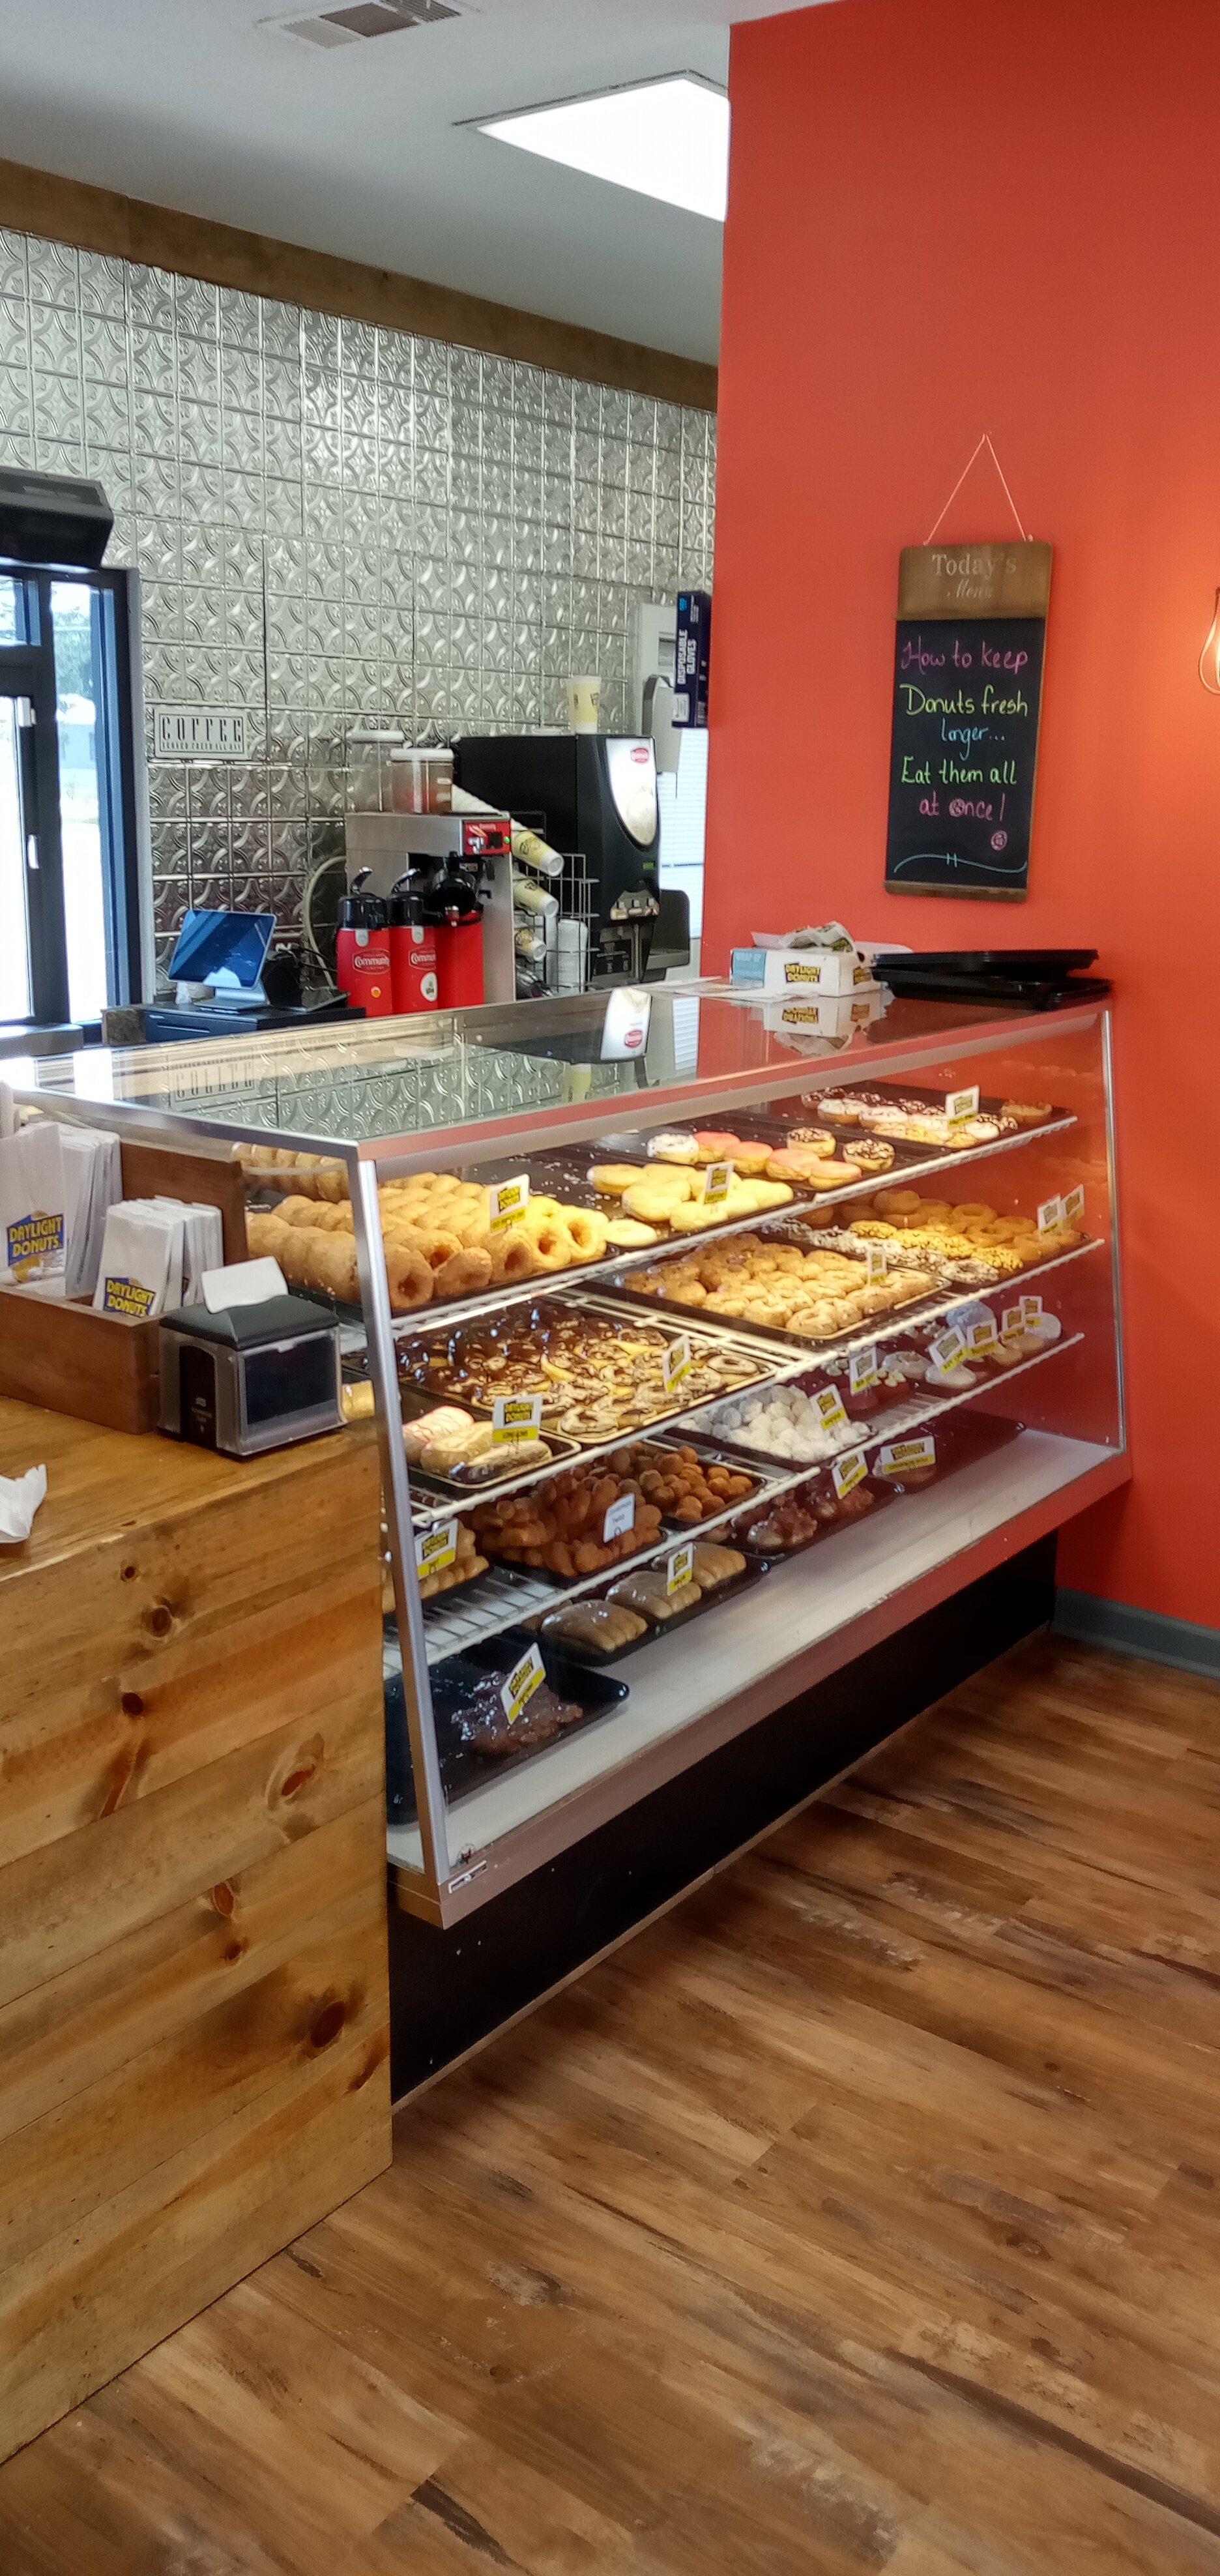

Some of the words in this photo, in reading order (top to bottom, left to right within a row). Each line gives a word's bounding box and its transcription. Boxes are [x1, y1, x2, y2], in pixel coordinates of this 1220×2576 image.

[931, 552, 1017, 579] Today's
[677, 629, 688, 684] DISPOSABLE
[686, 639, 697, 675] GLOVES
[901, 636, 945, 675] How
[952, 639, 972, 668] to
[981, 640, 1028, 674] keep
[899, 683, 976, 716] Donuts
[981, 684, 1028, 717] fresh
[162, 716, 241, 742] COFFEE
[901, 755, 931, 784] Eat
[938, 758, 983, 784] them
[990, 759, 1017, 785] all
[919, 789, 940, 817] at
[10, 1216, 63, 1243] DAYLIGHT
[12, 1235, 60, 1257] DONUTS
[106, 1279, 155, 1305] DAYLIGHT
[108, 1294, 148, 1317] DONUTS
